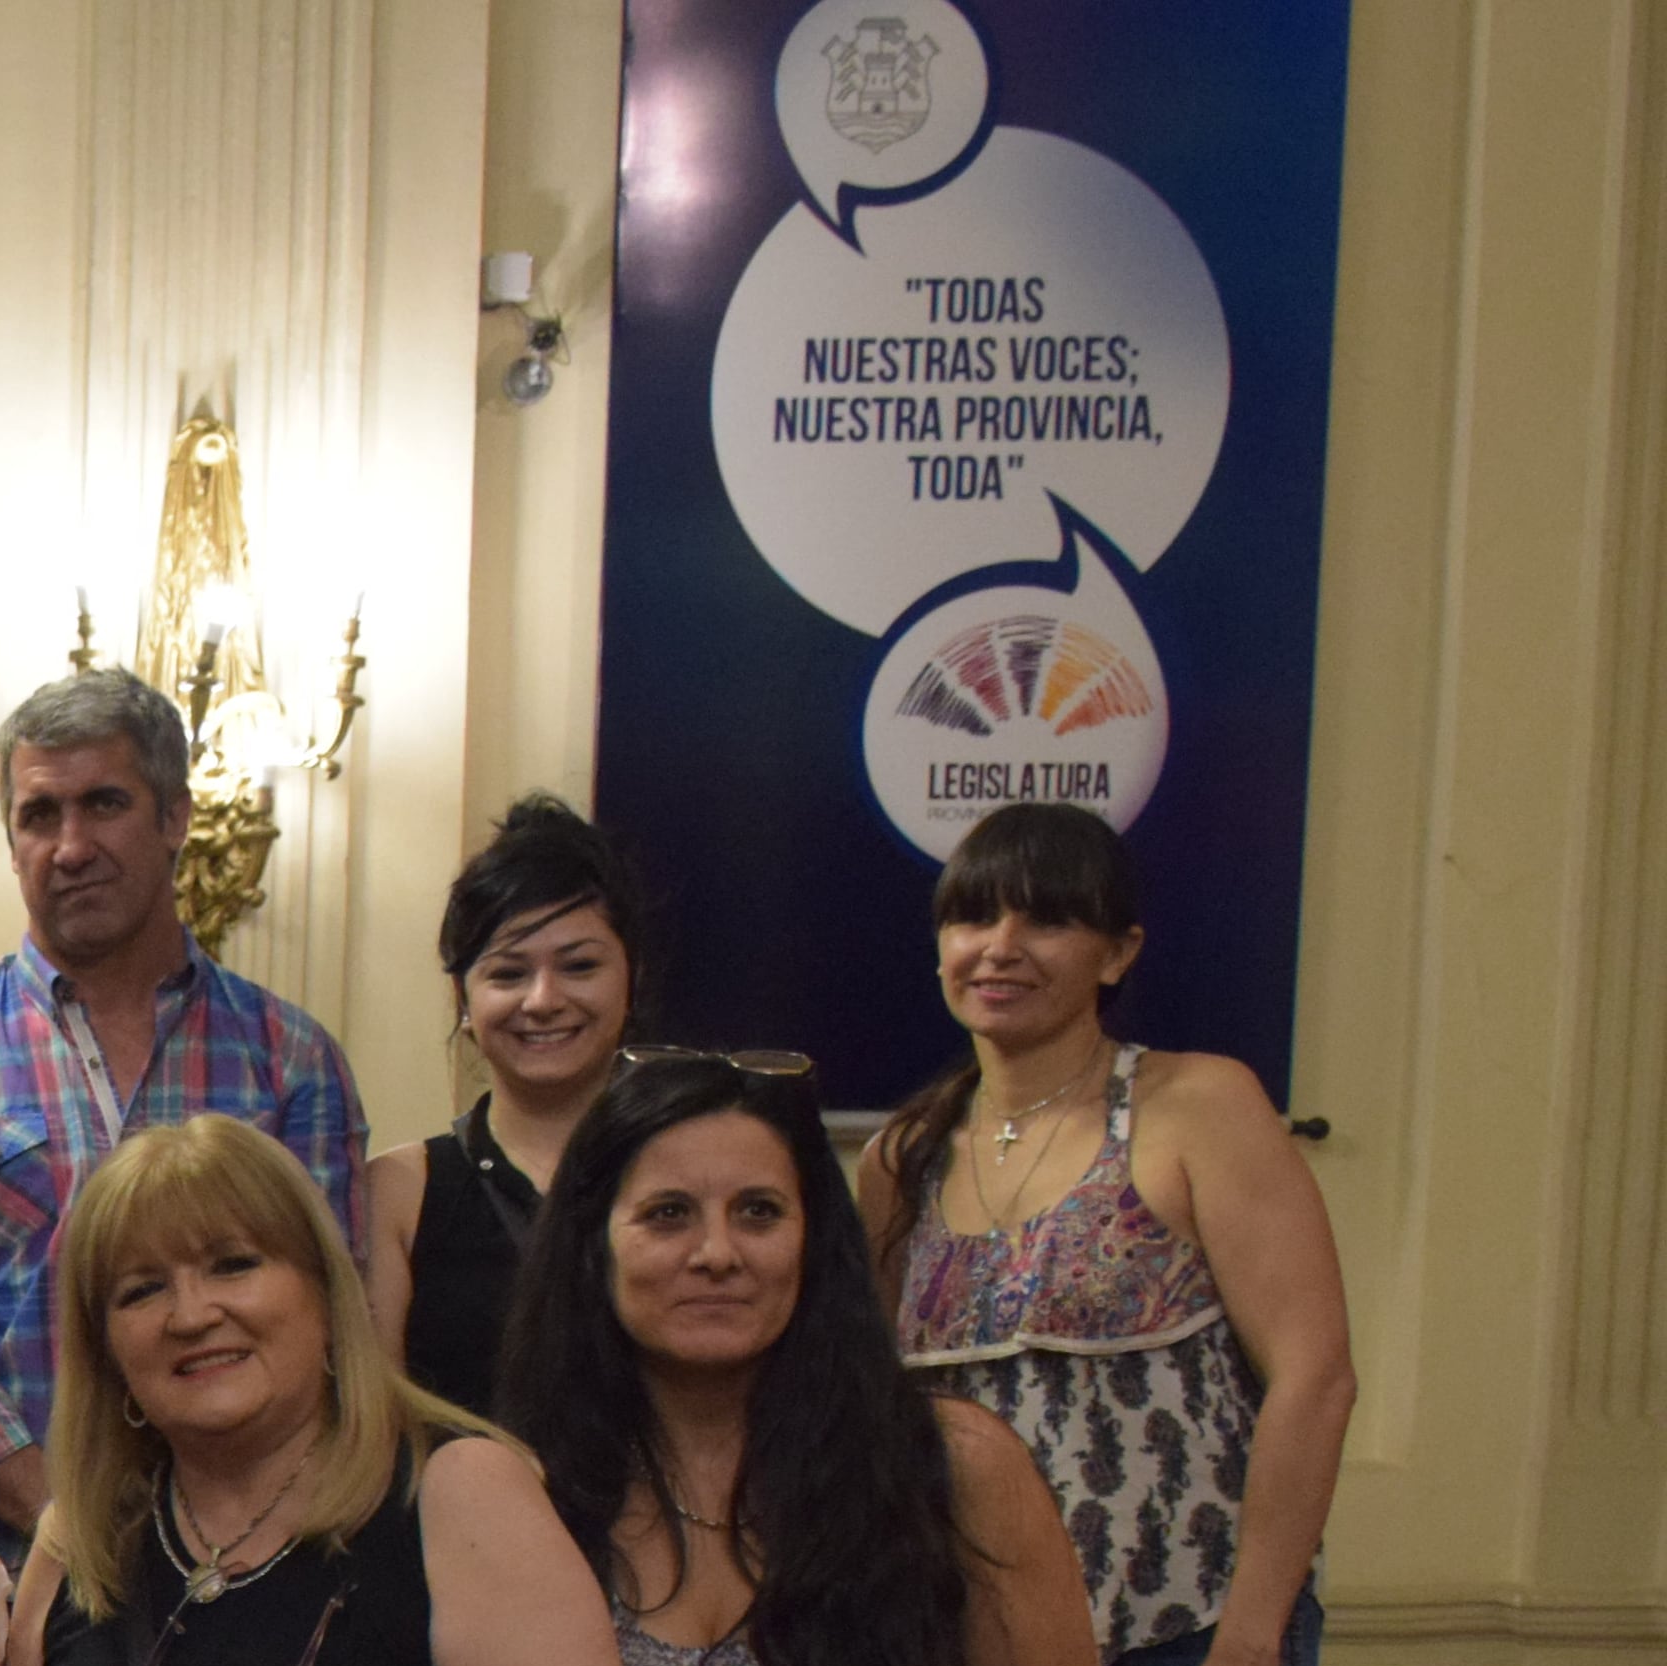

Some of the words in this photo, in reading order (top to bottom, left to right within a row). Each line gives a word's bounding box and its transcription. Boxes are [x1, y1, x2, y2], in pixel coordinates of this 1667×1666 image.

[906, 276, 1045, 324] "TODAS
[803, 337, 997, 384] NUESTRAS
[1010, 335, 1141, 387] VOCES;
[774, 396, 942, 442] NUESTRA
[955, 394, 1164, 446] PROVINCIA,
[908, 454, 1024, 501] TODA"
[927, 762, 1110, 800] LEGISLATURA
